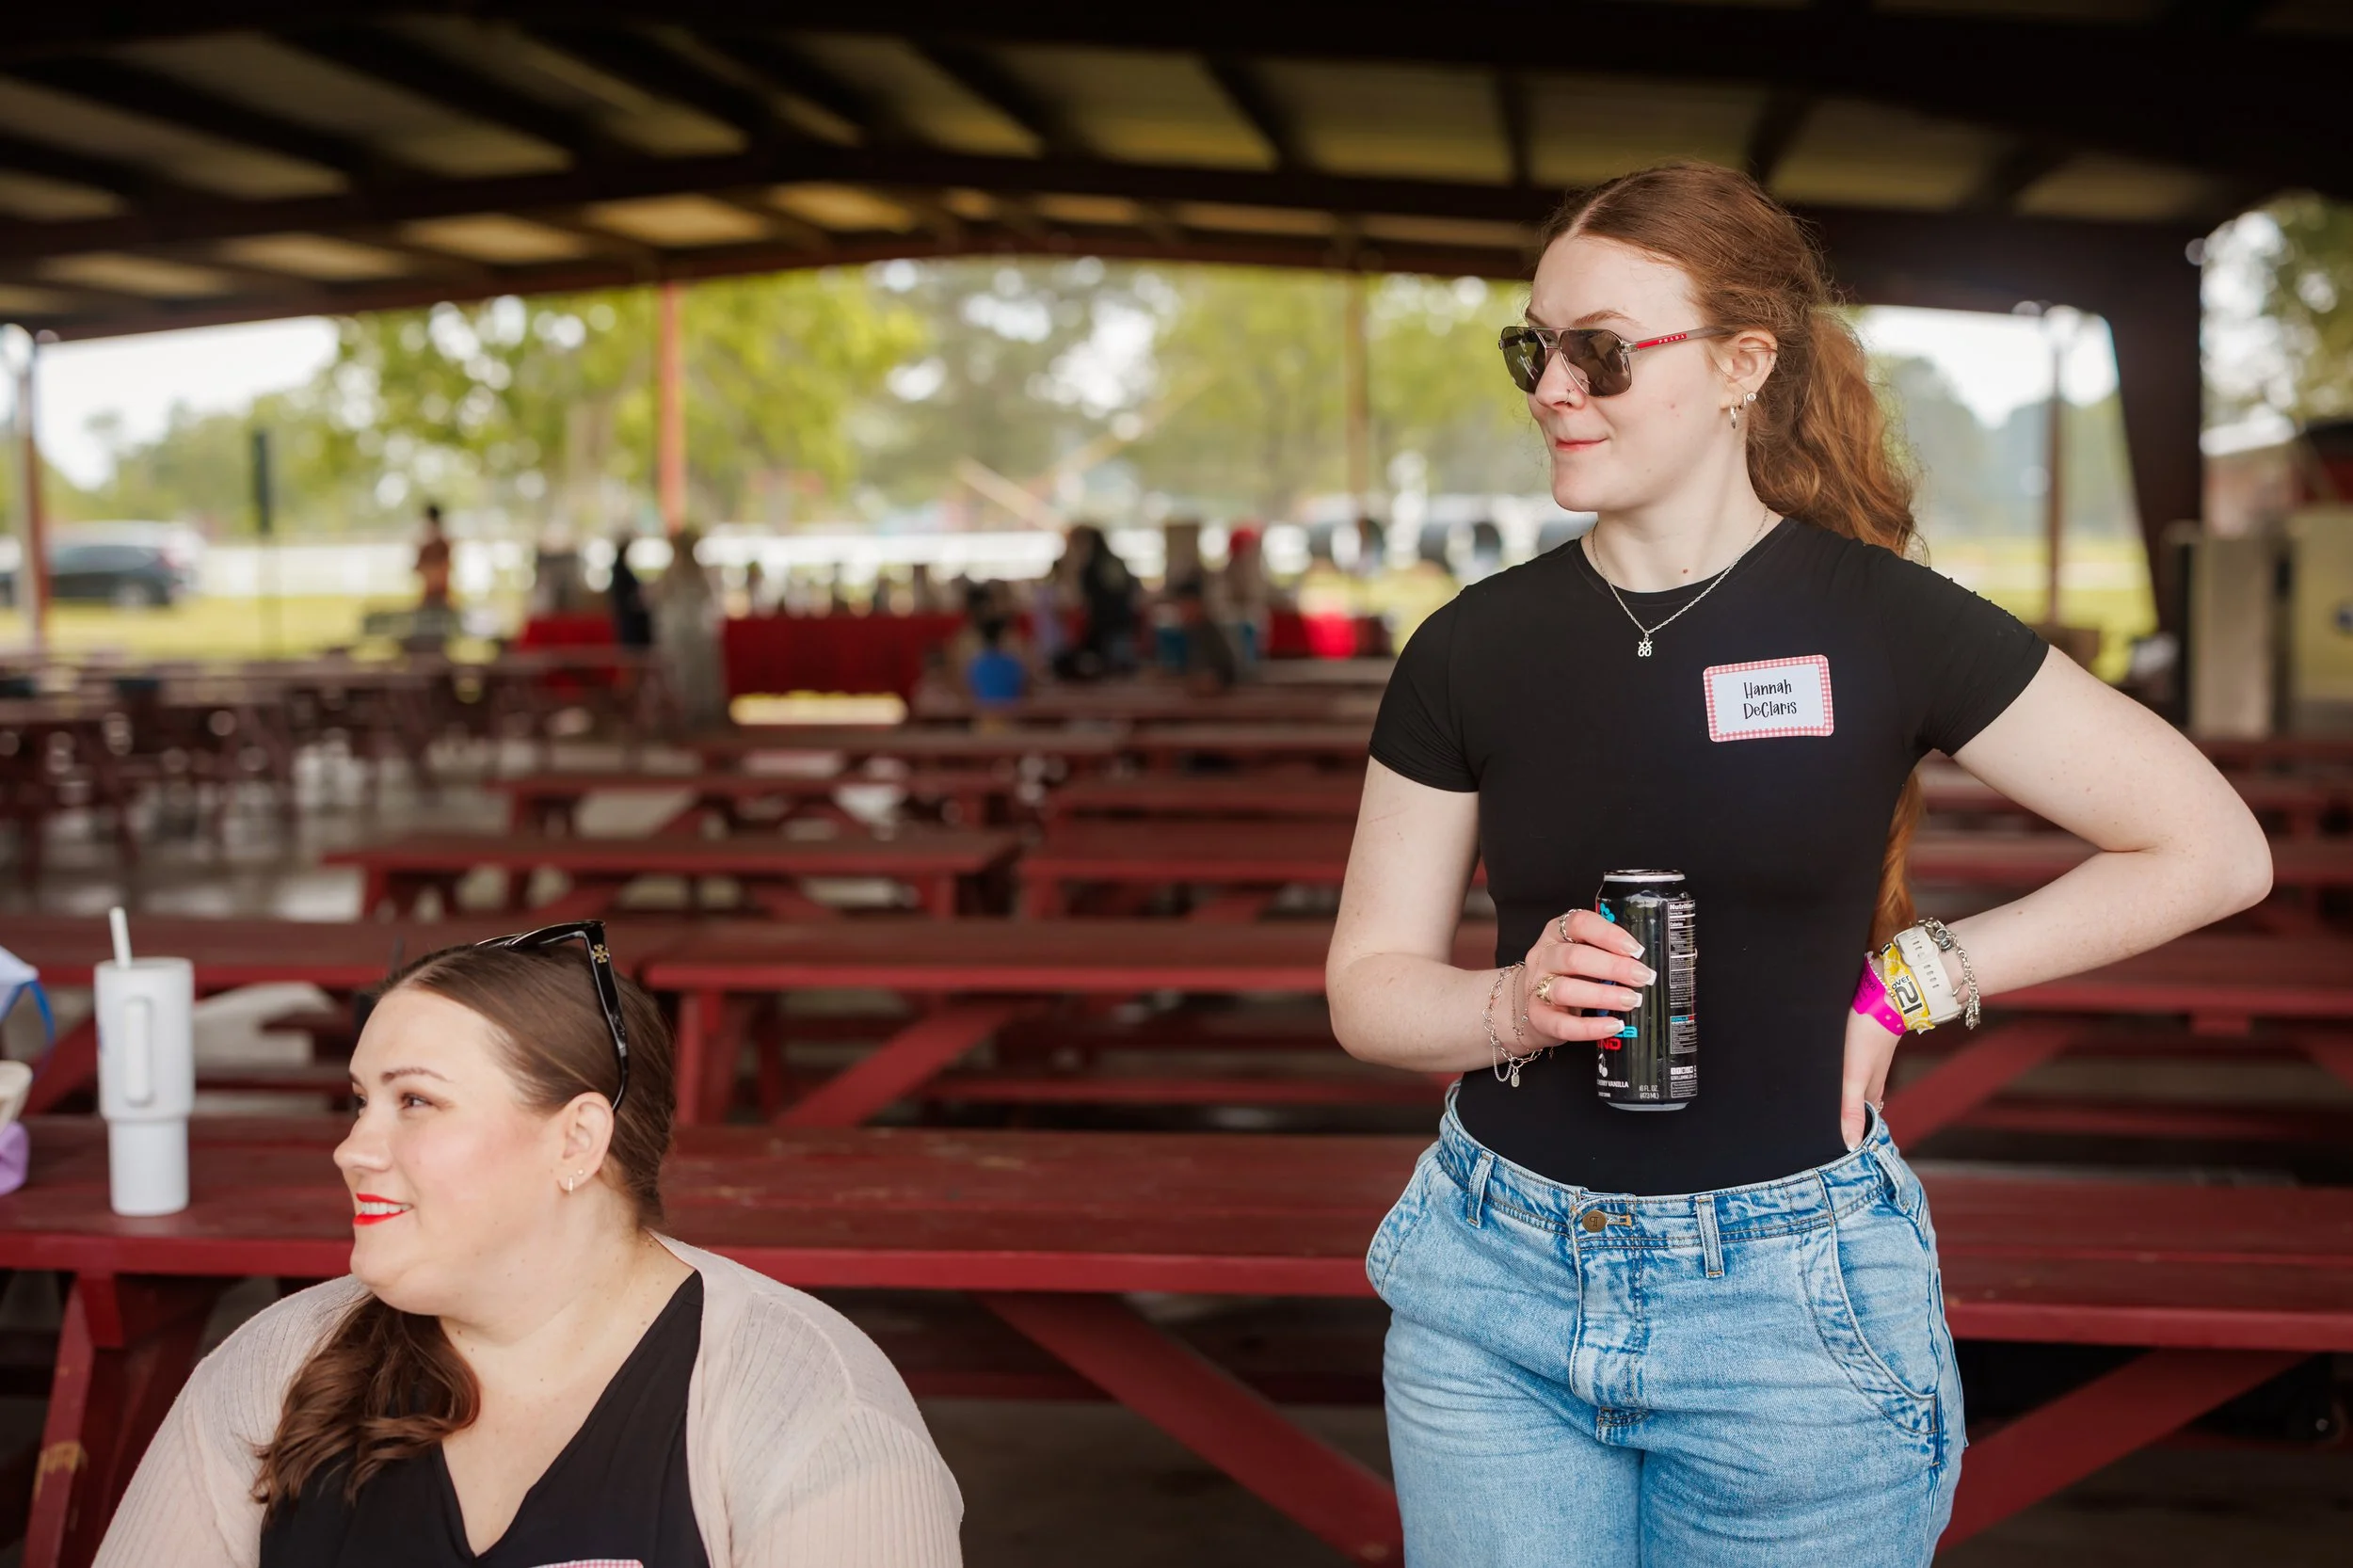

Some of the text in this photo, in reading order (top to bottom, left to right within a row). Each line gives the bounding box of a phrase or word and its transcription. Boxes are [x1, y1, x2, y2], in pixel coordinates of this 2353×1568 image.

[1658, 334, 1685, 344] PRADA
[1743, 679, 1792, 699] Hannah
[1743, 700, 1798, 720] DeClaris
[1895, 982, 1923, 1015] 21
